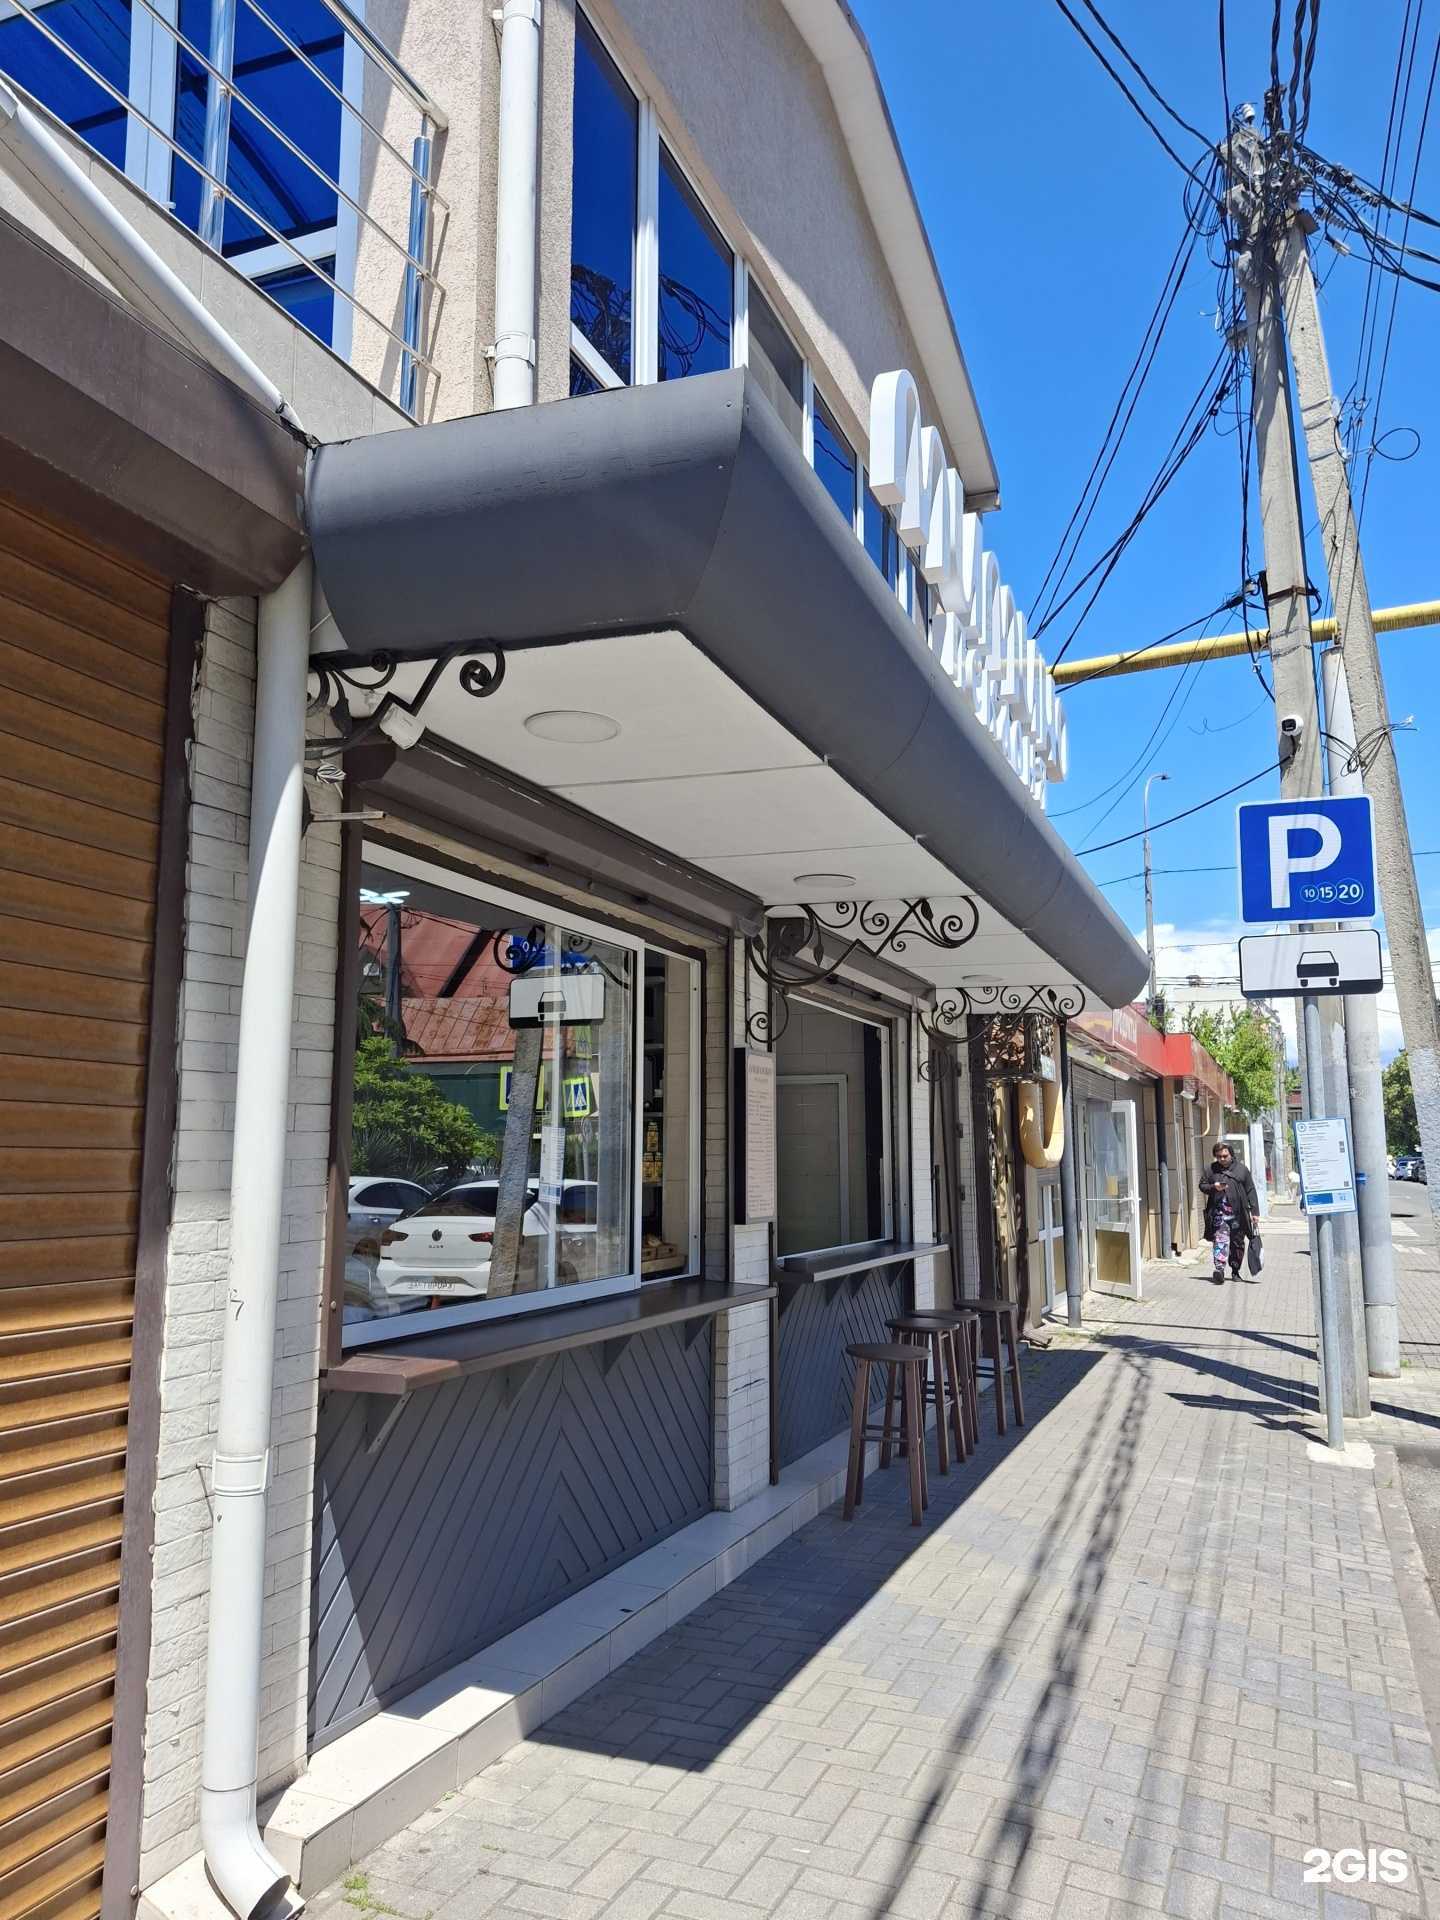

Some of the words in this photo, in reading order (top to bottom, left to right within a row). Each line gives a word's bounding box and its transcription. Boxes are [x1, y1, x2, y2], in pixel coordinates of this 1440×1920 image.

[1268, 813, 1342, 909] P
[1304, 888, 1316, 898] 10
[1319, 887, 1334, 898] 15
[1338, 884, 1360, 899] 20
